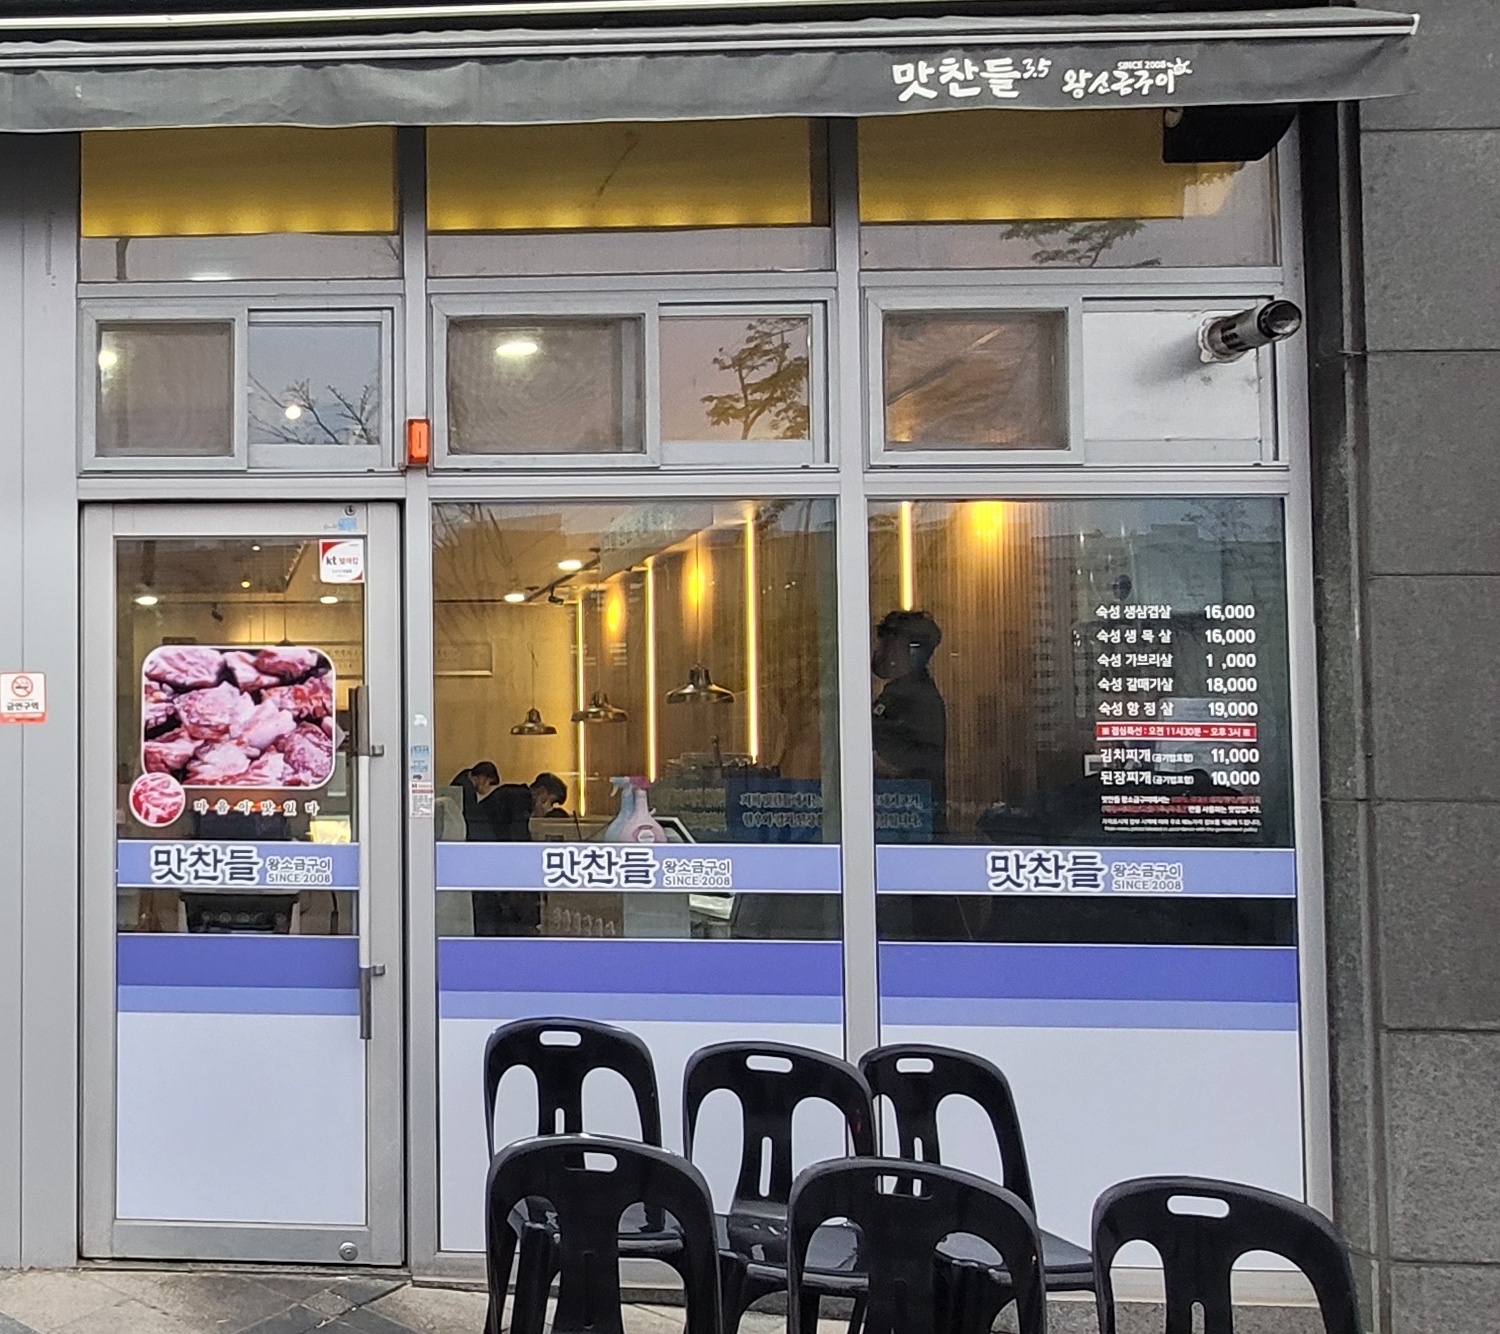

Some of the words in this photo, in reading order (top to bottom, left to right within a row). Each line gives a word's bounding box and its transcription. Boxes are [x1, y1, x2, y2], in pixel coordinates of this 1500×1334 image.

[1117, 61, 1143, 70] SINCE
[1144, 60, 1166, 69] 2008
[892, 57, 1021, 101] 맛찬들
[1022, 58, 1051, 78] 3.5
[1062, 68, 1176, 99] 왕소금구이
[326, 556, 337, 565] kt
[1095, 605, 1120, 619] 숙성
[1123, 605, 1172, 619] 생삼겹살
[1204, 605, 1255, 621] 16,000
[1096, 629, 1121, 643] 숙성
[1205, 629, 1256, 645] 16,000
[1097, 653, 1122, 667] 숙성
[1125, 653, 1173, 667] 가브리살
[1097, 677, 1122, 692] 숙성
[1126, 677, 1174, 692] 갈매기살
[1206, 677, 1257, 694] 18,000
[1098, 701, 1123, 716] 숙성
[1208, 701, 1258, 718] 19,000
[1100, 748, 1151, 763] 김치찌개
[1211, 748, 1259, 765] 11,000
[1100, 771, 1151, 785] 된장찌개
[1211, 771, 1260, 787] 10,000
[150, 845, 260, 884] 맛찬들
[266, 858, 331, 873] 왕소금구이
[543, 847, 656, 888] 맛찬들
[664, 859, 732, 875] 왕소금구이
[987, 850, 1104, 892] 맛찬들
[1113, 863, 1182, 879] 왕소금구이
[267, 873, 301, 884] SINCE
[303, 872, 331, 884] 2008
[664, 875, 700, 886] SINCE
[702, 875, 731, 886] 2008
[1113, 880, 1149, 891] SINCE
[1151, 880, 1183, 891] 2008
